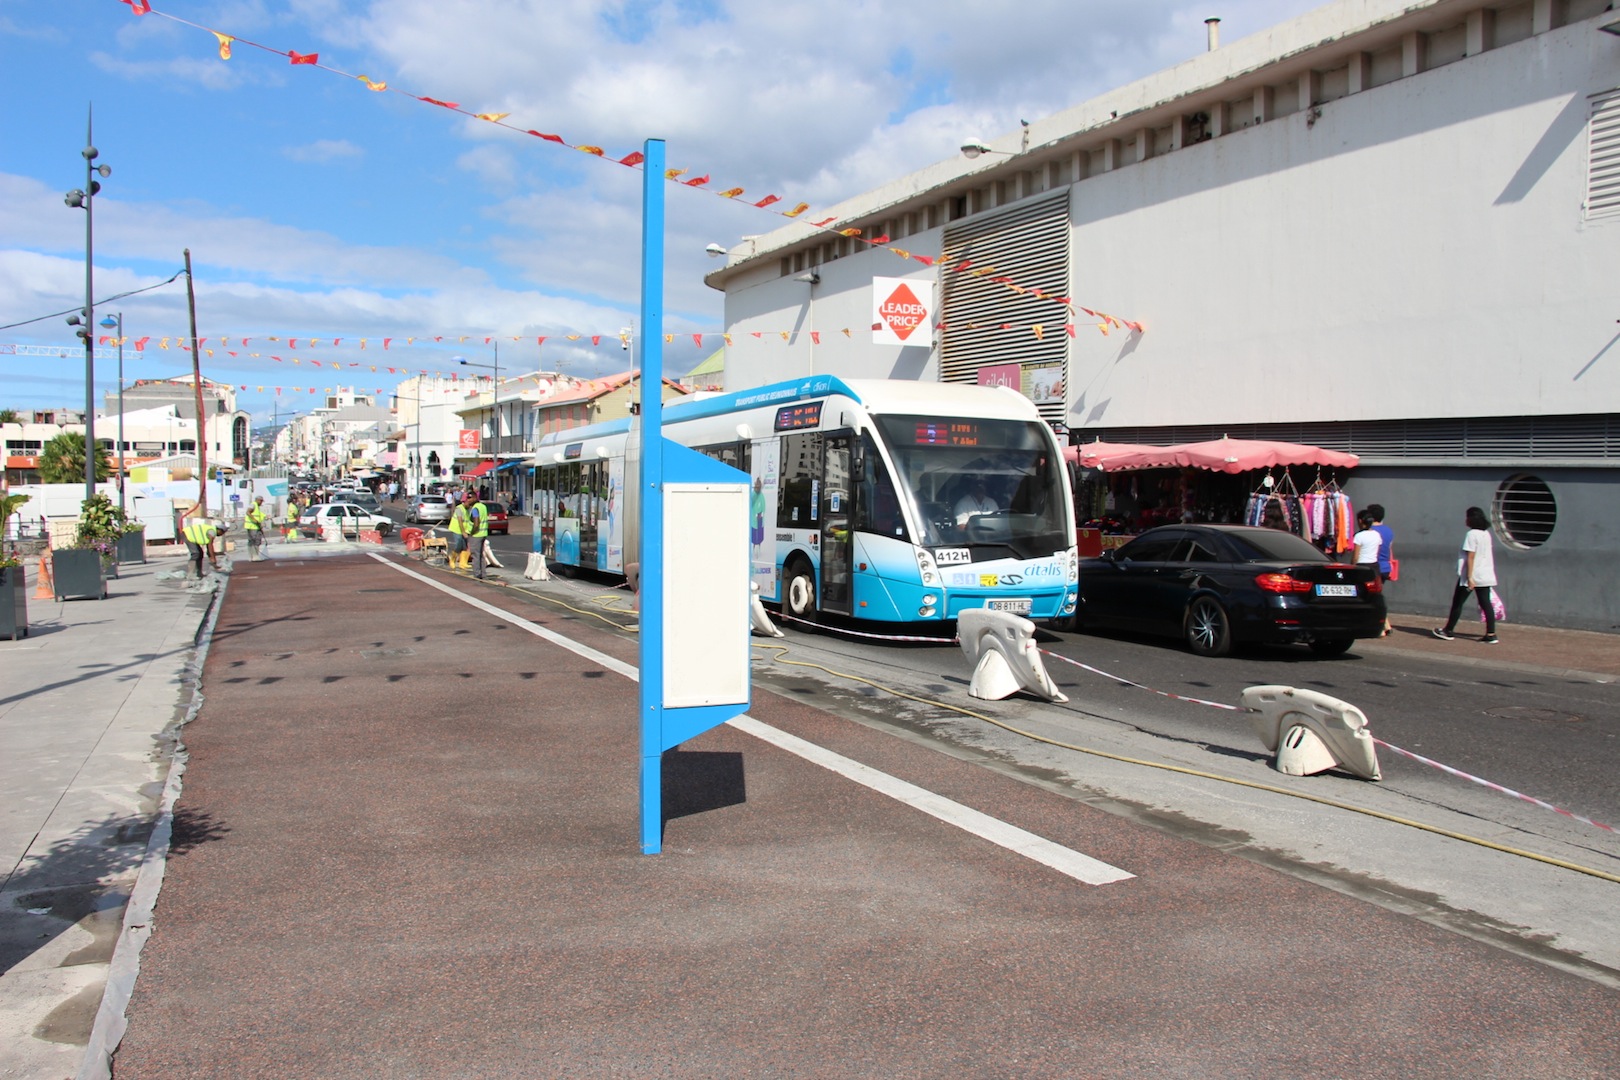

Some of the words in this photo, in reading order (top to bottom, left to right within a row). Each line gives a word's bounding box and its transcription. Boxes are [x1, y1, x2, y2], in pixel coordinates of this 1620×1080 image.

[881, 303, 925, 315] LEADER
[886, 315, 918, 327] PRICE
[755, 392, 771, 403] PUBLIC
[937, 551, 969, 561] 412H
[1024, 562, 1062, 576] citalis
